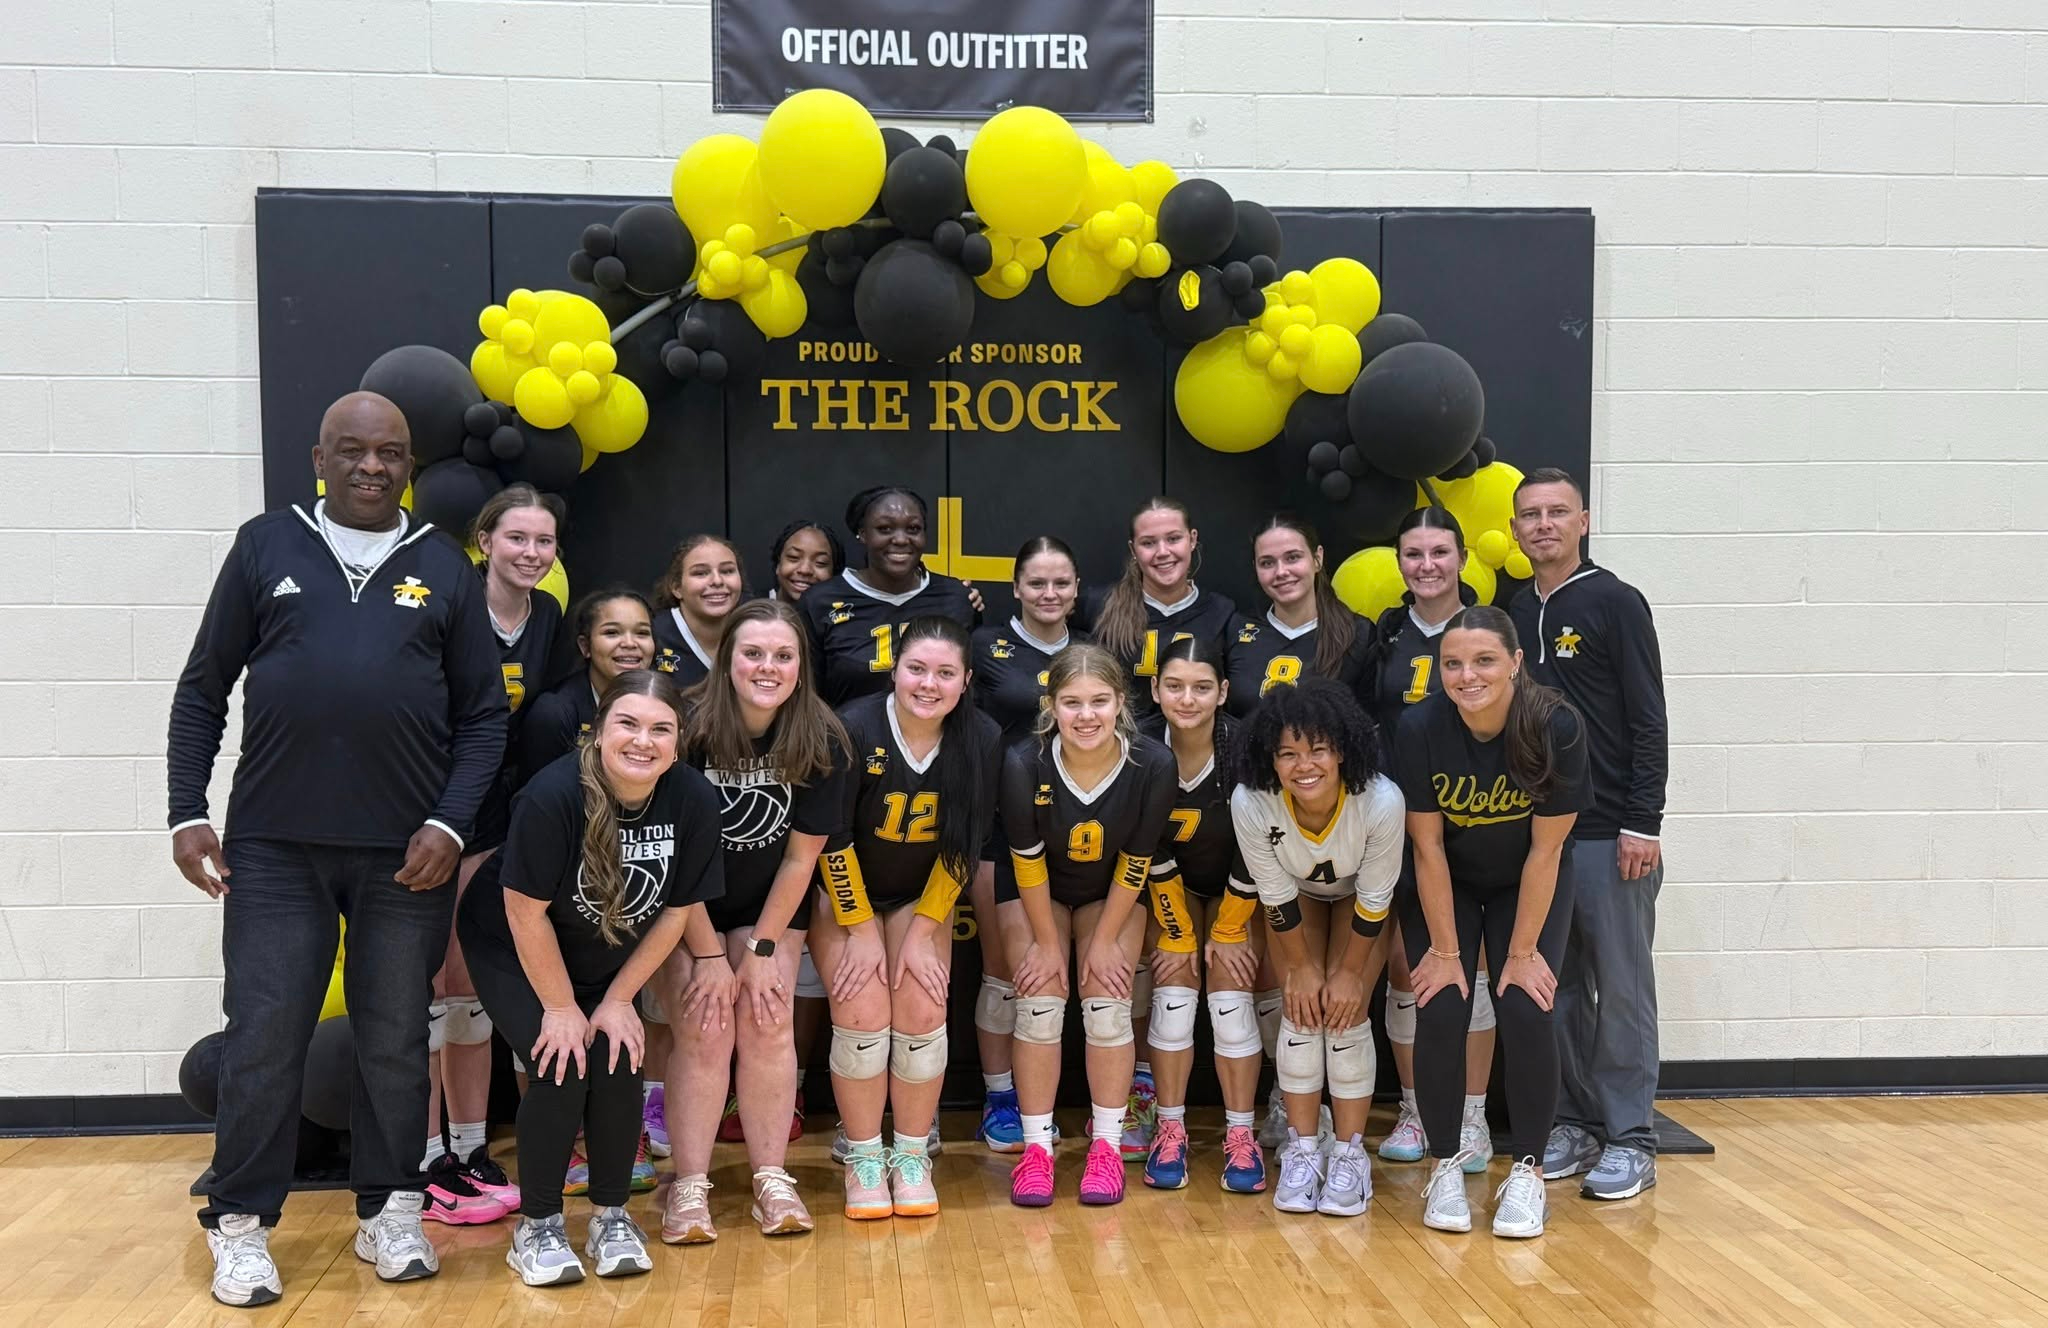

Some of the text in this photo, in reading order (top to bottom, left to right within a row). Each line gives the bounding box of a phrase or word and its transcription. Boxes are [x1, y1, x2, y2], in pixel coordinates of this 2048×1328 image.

[781, 27, 1089, 70] OFFICIAL OUTFITTER
[799, 341, 879, 362] PROUD
[970, 343, 1083, 364] SPONSOR
[760, 379, 1121, 432] THE ROCK
[273, 586, 301, 598] adidas
[869, 623, 910, 673] 1
[1133, 629, 1195, 677] 1
[1260, 655, 1304, 699] 8
[1403, 655, 1434, 704] 1
[1431, 772, 1533, 814] Wolve
[721, 821, 792, 852] LEYBALL
[874, 791, 941, 843] 12
[1168, 807, 1202, 843] 7
[1067, 819, 1104, 863] 9
[827, 854, 858, 913] WOLVES
[1304, 859, 1340, 885] 4
[571, 893, 664, 927] VOLLBALL
